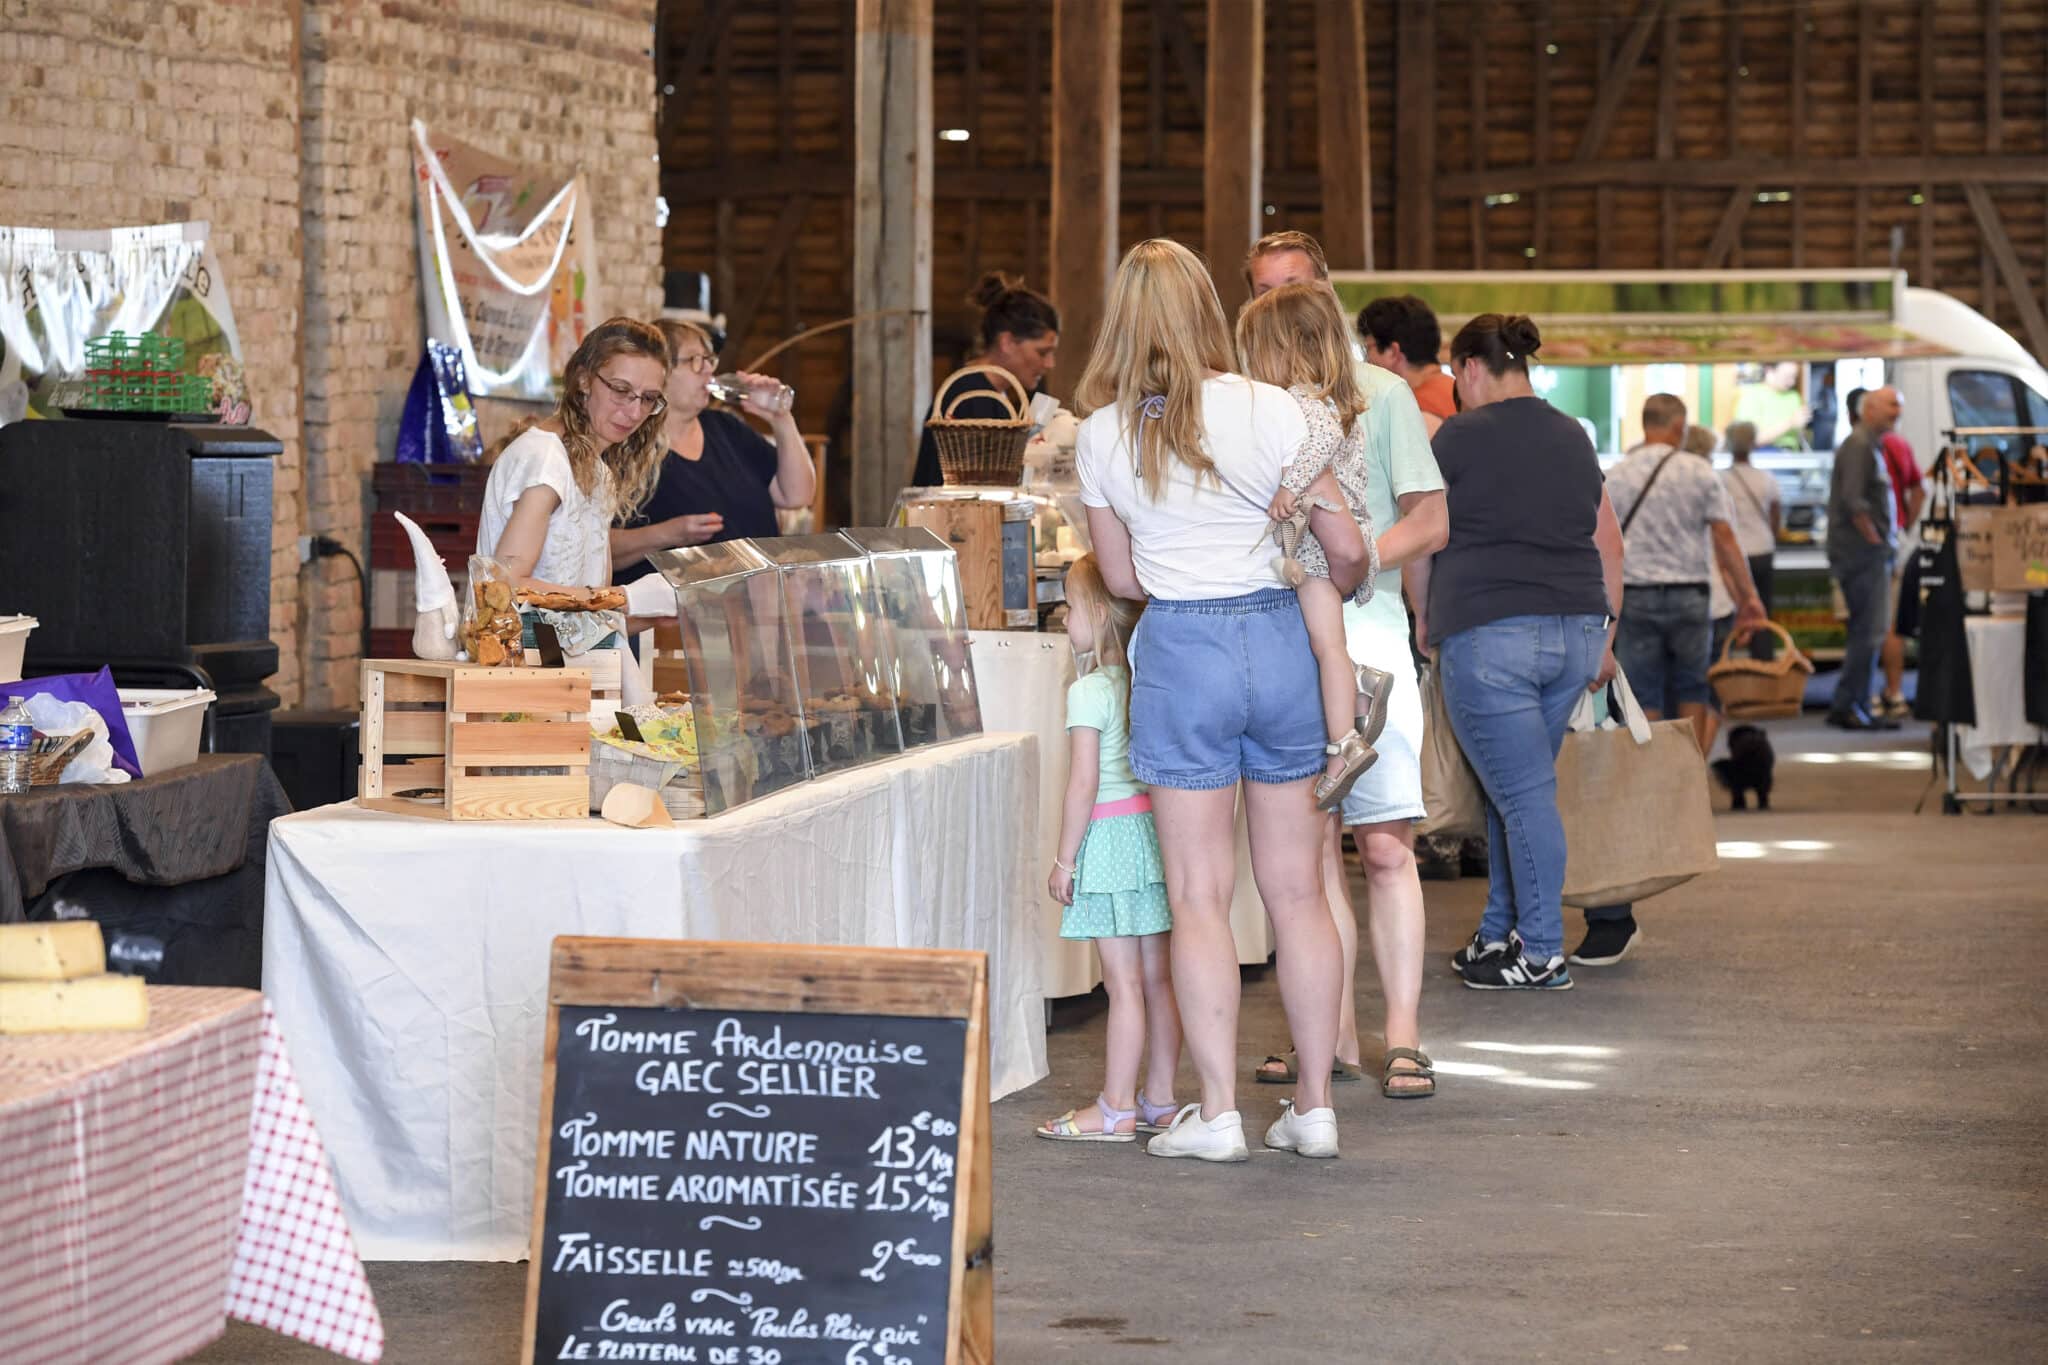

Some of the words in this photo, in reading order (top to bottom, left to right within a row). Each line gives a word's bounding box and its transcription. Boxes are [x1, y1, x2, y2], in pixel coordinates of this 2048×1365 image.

[575, 1013, 697, 1054] TOMME
[635, 1060, 724, 1096] GAEC
[559, 1112, 676, 1159] TOMME
[684, 1129, 818, 1164] NATURE
[556, 1160, 660, 1200] TOMME
[708, 1346, 740, 1364] DE
[746, 1345, 782, 1365] 30
